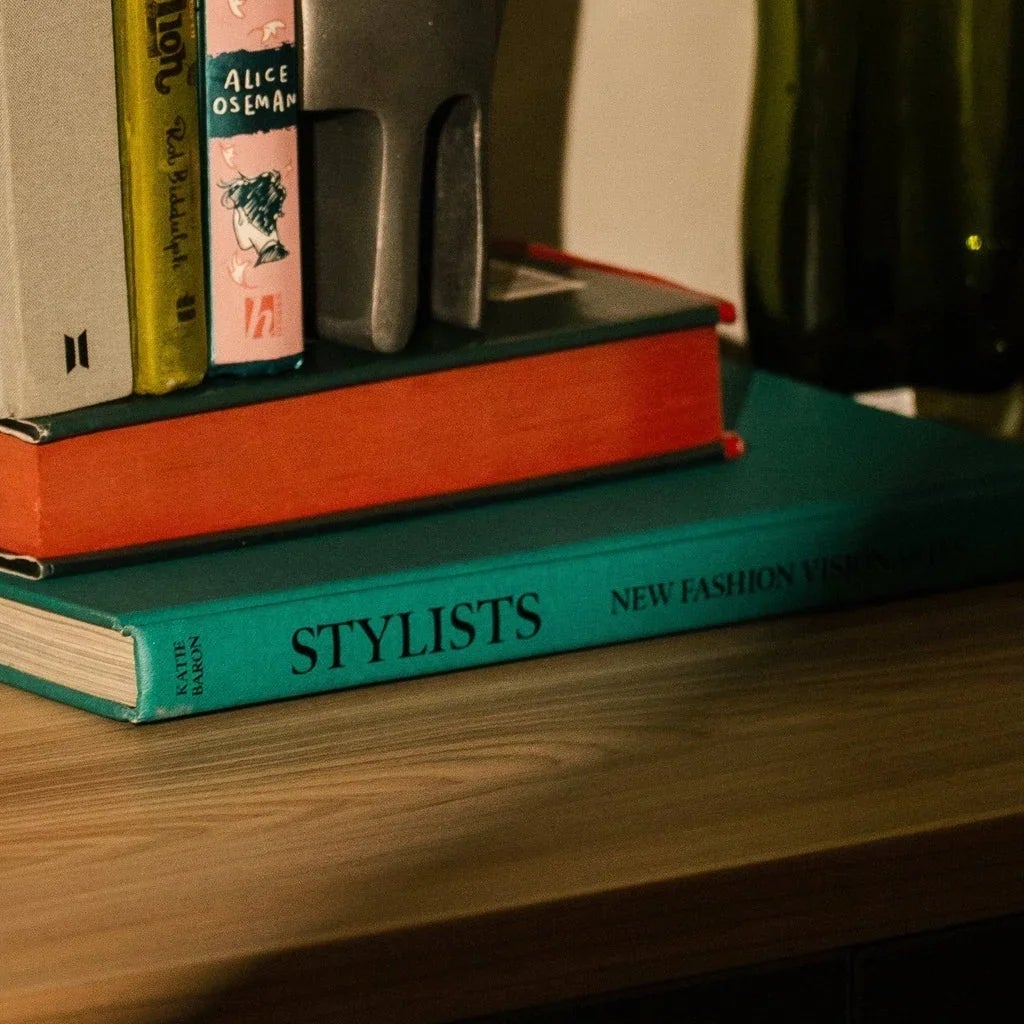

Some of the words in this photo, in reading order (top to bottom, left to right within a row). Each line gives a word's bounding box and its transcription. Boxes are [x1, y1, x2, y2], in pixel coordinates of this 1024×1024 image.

[212, 89, 296, 116] OSEMAN
[224, 64, 288, 93] ALICE
[610, 581, 675, 615] NEW
[680, 562, 793, 605] FASHION
[290, 592, 542, 675] STYLISTS
[173, 640, 188, 695] KATIE
[188, 635, 204, 696] BARON
